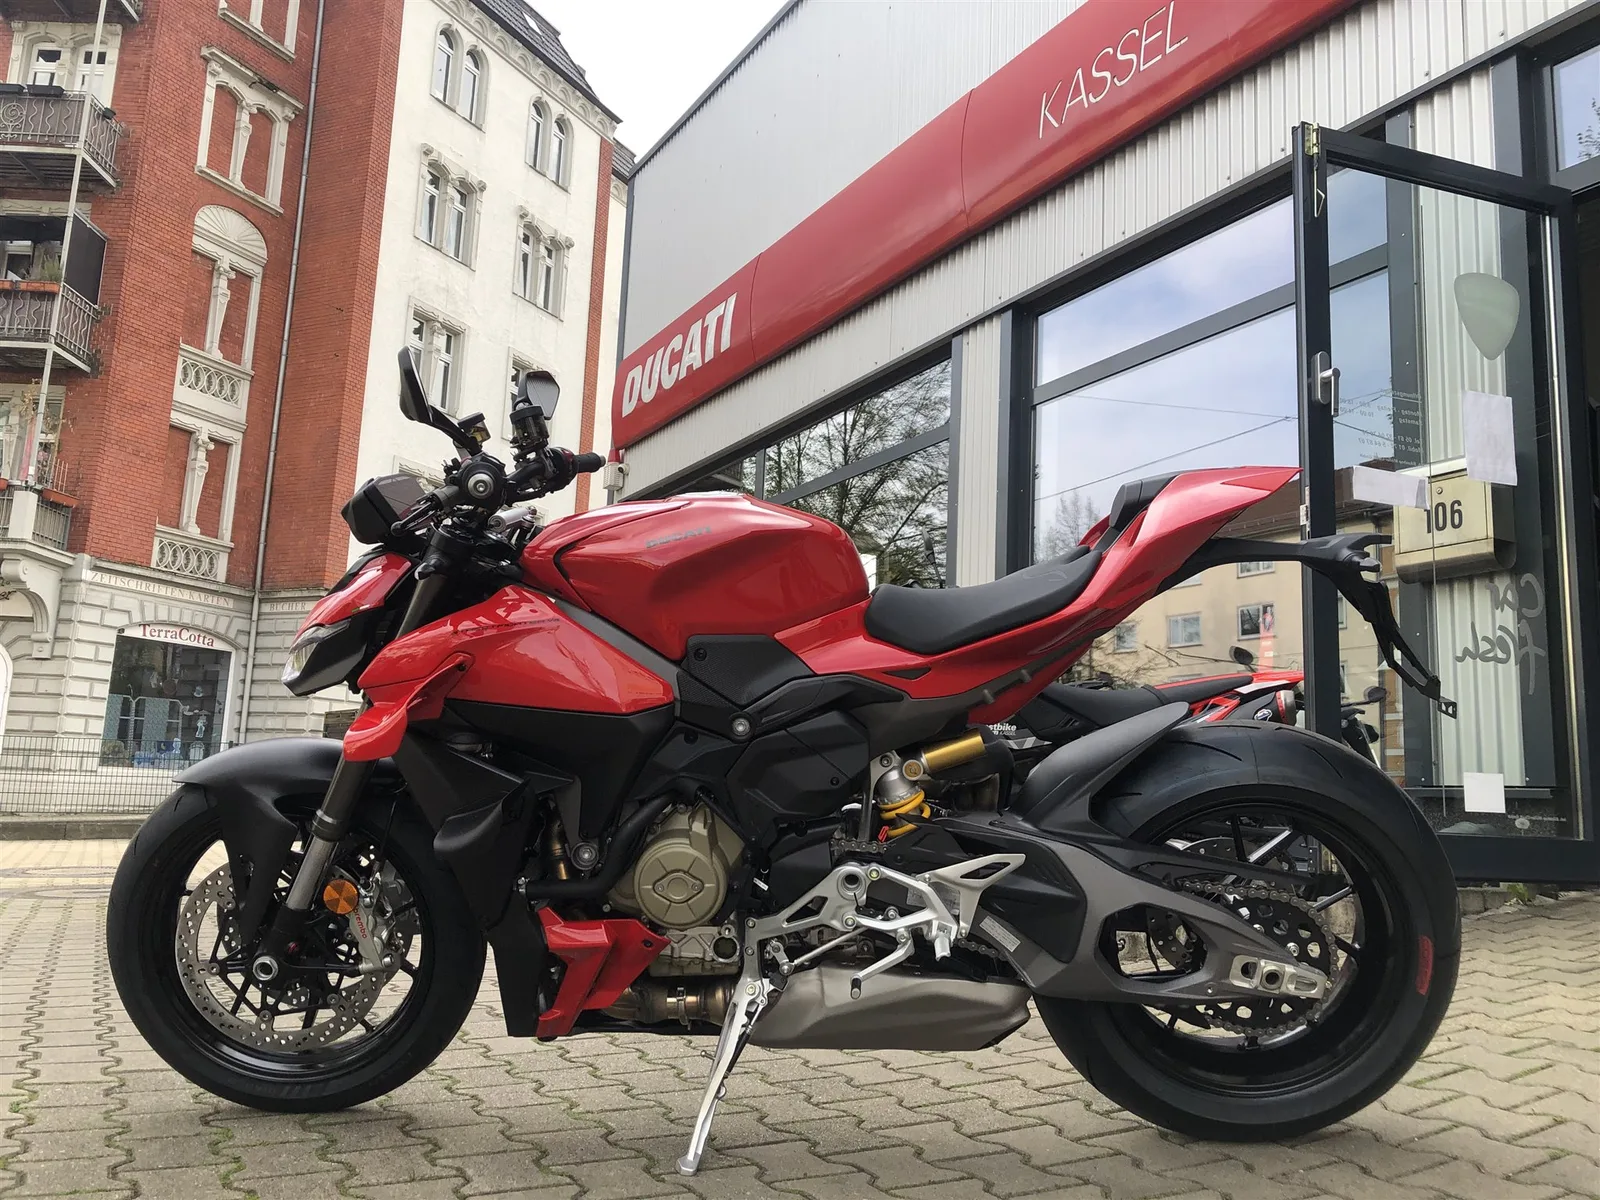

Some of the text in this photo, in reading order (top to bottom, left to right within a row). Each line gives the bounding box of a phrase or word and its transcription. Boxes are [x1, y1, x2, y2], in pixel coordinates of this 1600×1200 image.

[1039, 0, 1189, 139] KASSEL
[622, 291, 737, 418] DUCATI
[1424, 500, 1463, 534] 106
[139, 623, 215, 648] TerraCotta
